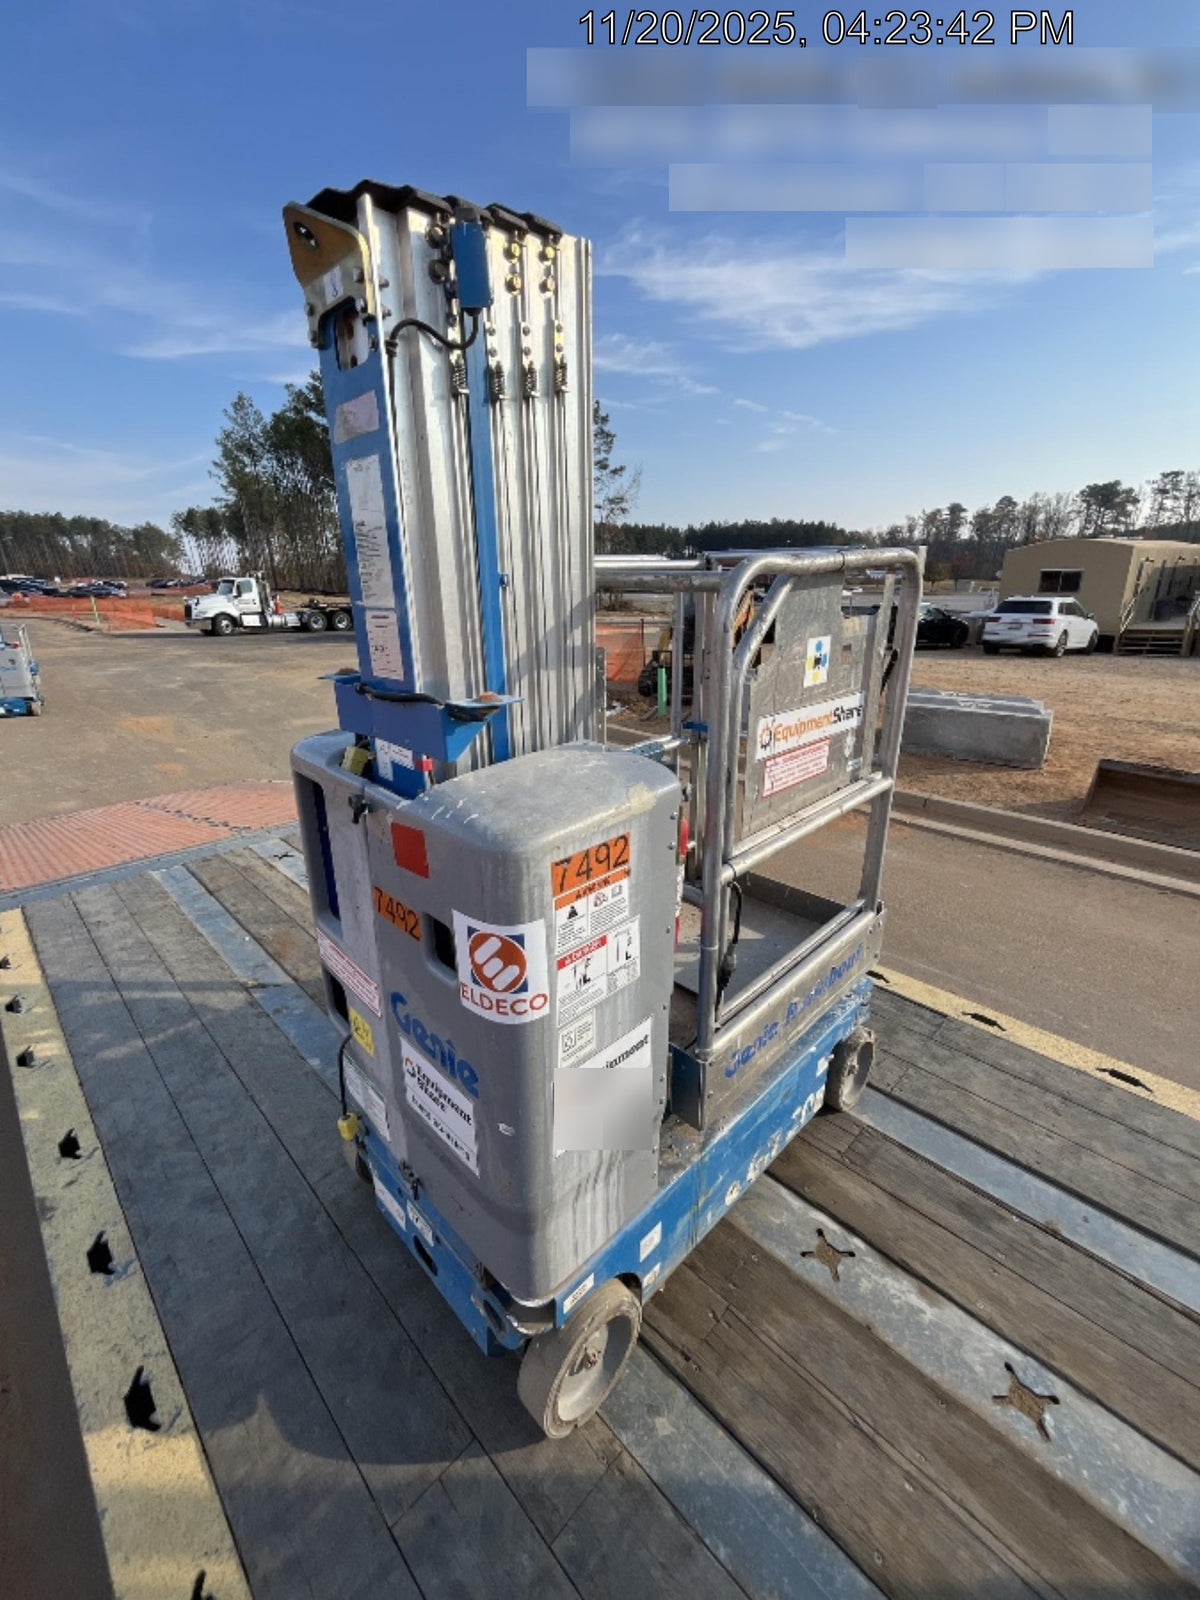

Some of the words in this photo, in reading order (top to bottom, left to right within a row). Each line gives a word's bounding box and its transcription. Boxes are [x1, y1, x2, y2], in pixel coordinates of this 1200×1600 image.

[554, 834, 629, 895] 7492
[373, 886, 421, 942] 7492
[459, 981, 548, 1016] ELDECO
[390, 991, 479, 1099] Genie
